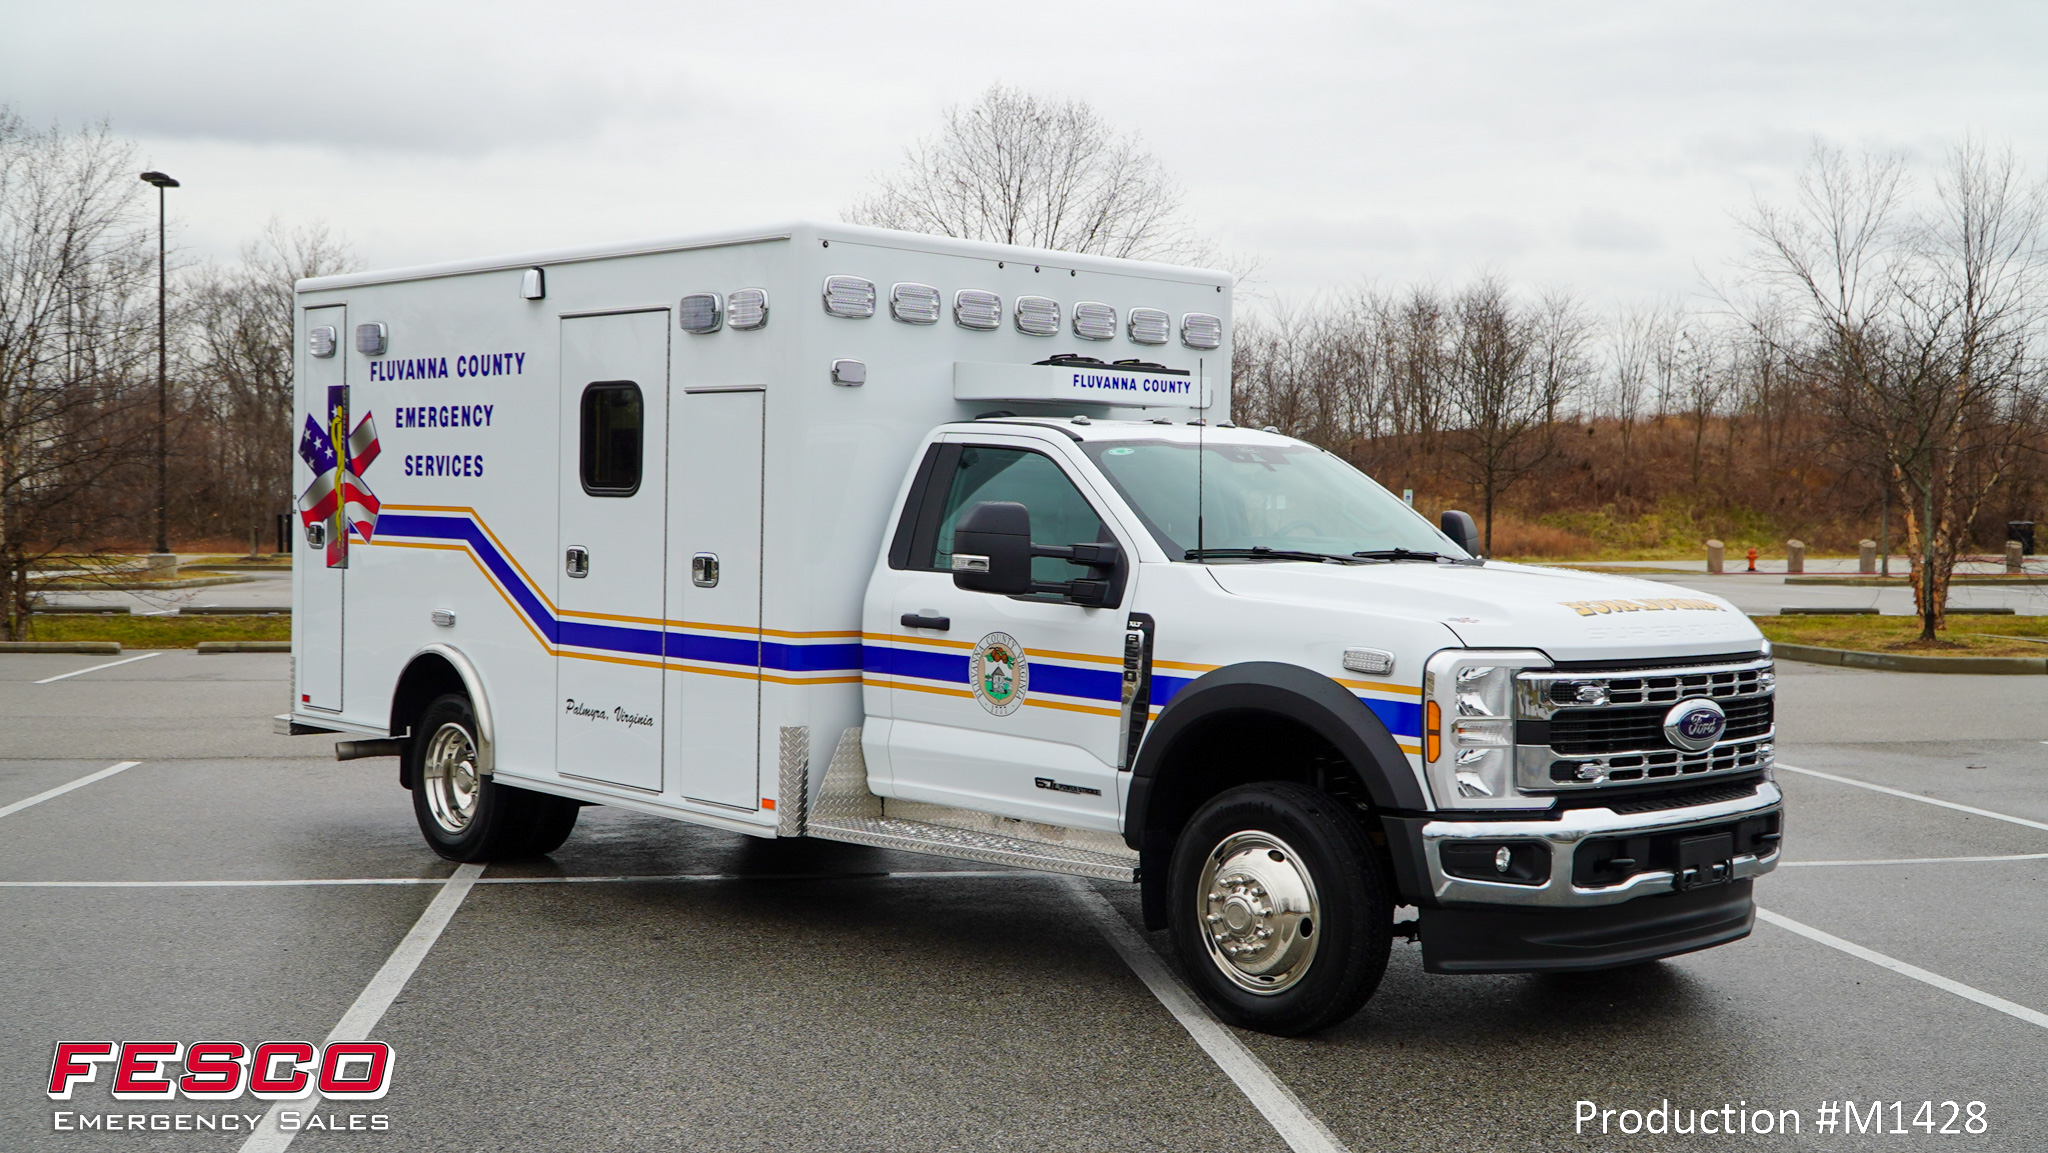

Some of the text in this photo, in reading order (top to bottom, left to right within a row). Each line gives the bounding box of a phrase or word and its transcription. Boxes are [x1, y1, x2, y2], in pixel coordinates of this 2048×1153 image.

[371, 352, 526, 382] FLUVANNA COUNTY
[1073, 373, 1191, 394] FLUVANNA COUNTY
[396, 405, 494, 429] EMERGENCY
[404, 454, 484, 478] SERVICES
[986, 633, 1017, 650] COUNTY
[1017, 652, 1027, 700] VIRGINIA
[565, 698, 655, 729] Palmyra, Virginia
[1688, 713, 1717, 735] Ford
